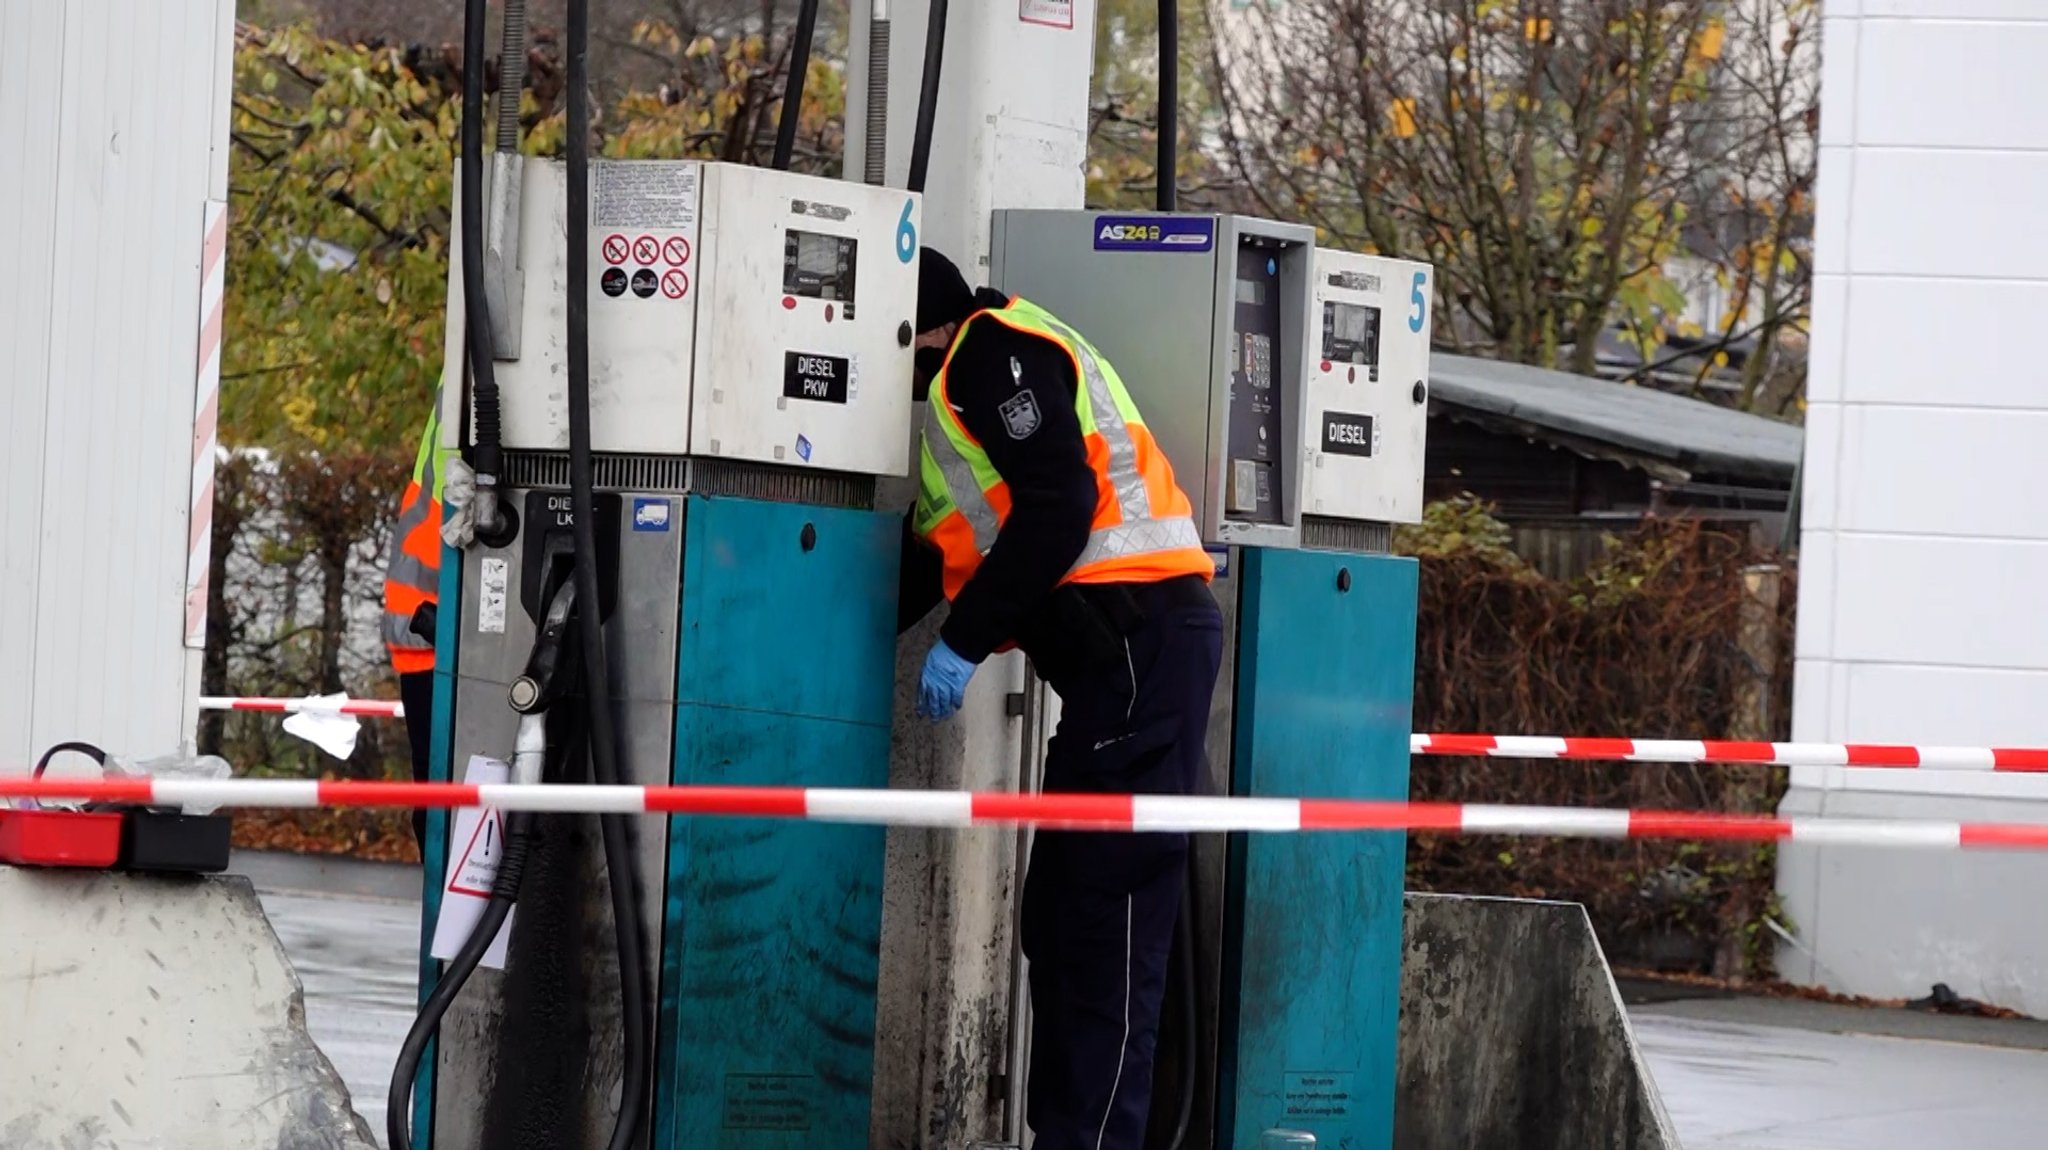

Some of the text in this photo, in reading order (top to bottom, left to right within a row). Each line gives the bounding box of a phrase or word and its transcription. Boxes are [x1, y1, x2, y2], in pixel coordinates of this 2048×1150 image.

[896, 198, 917, 264] 6
[1099, 224, 1148, 241] AS24
[1408, 271, 1426, 333] 5
[797, 355, 836, 378] DIESEL
[803, 378, 829, 397] PKW
[1328, 422, 1367, 445] DIESEL
[547, 496, 572, 511] DIE
[556, 511, 574, 525] LK
